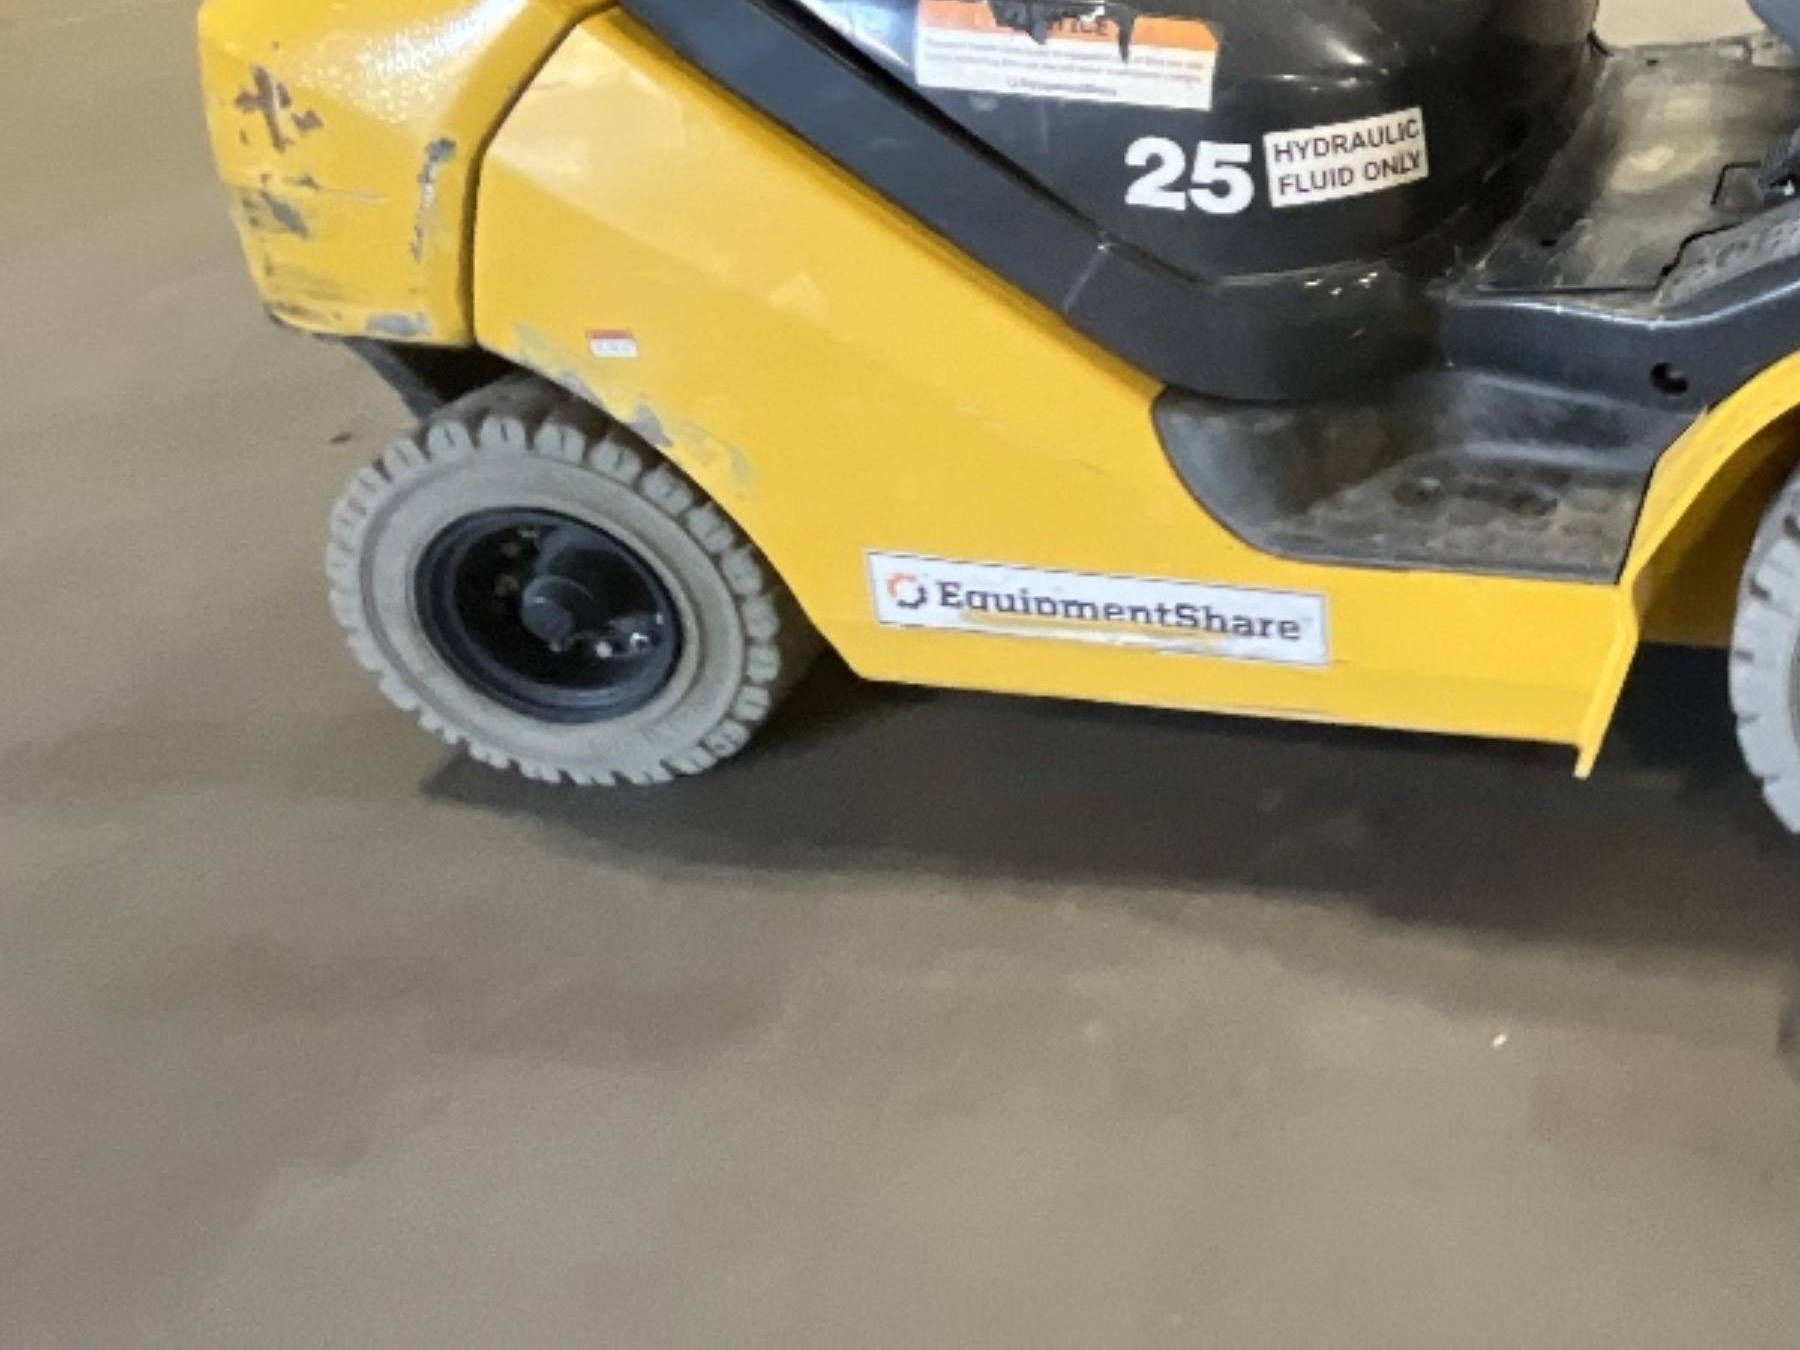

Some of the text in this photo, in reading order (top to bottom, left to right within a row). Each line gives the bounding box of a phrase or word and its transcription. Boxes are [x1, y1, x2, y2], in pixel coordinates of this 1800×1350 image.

[1272, 119, 1420, 163] HYDRAULIC
[1124, 135, 1255, 215] 25
[1279, 150, 1421, 196] FLUID ONLY
[938, 580, 1303, 642] EquipmentShare
